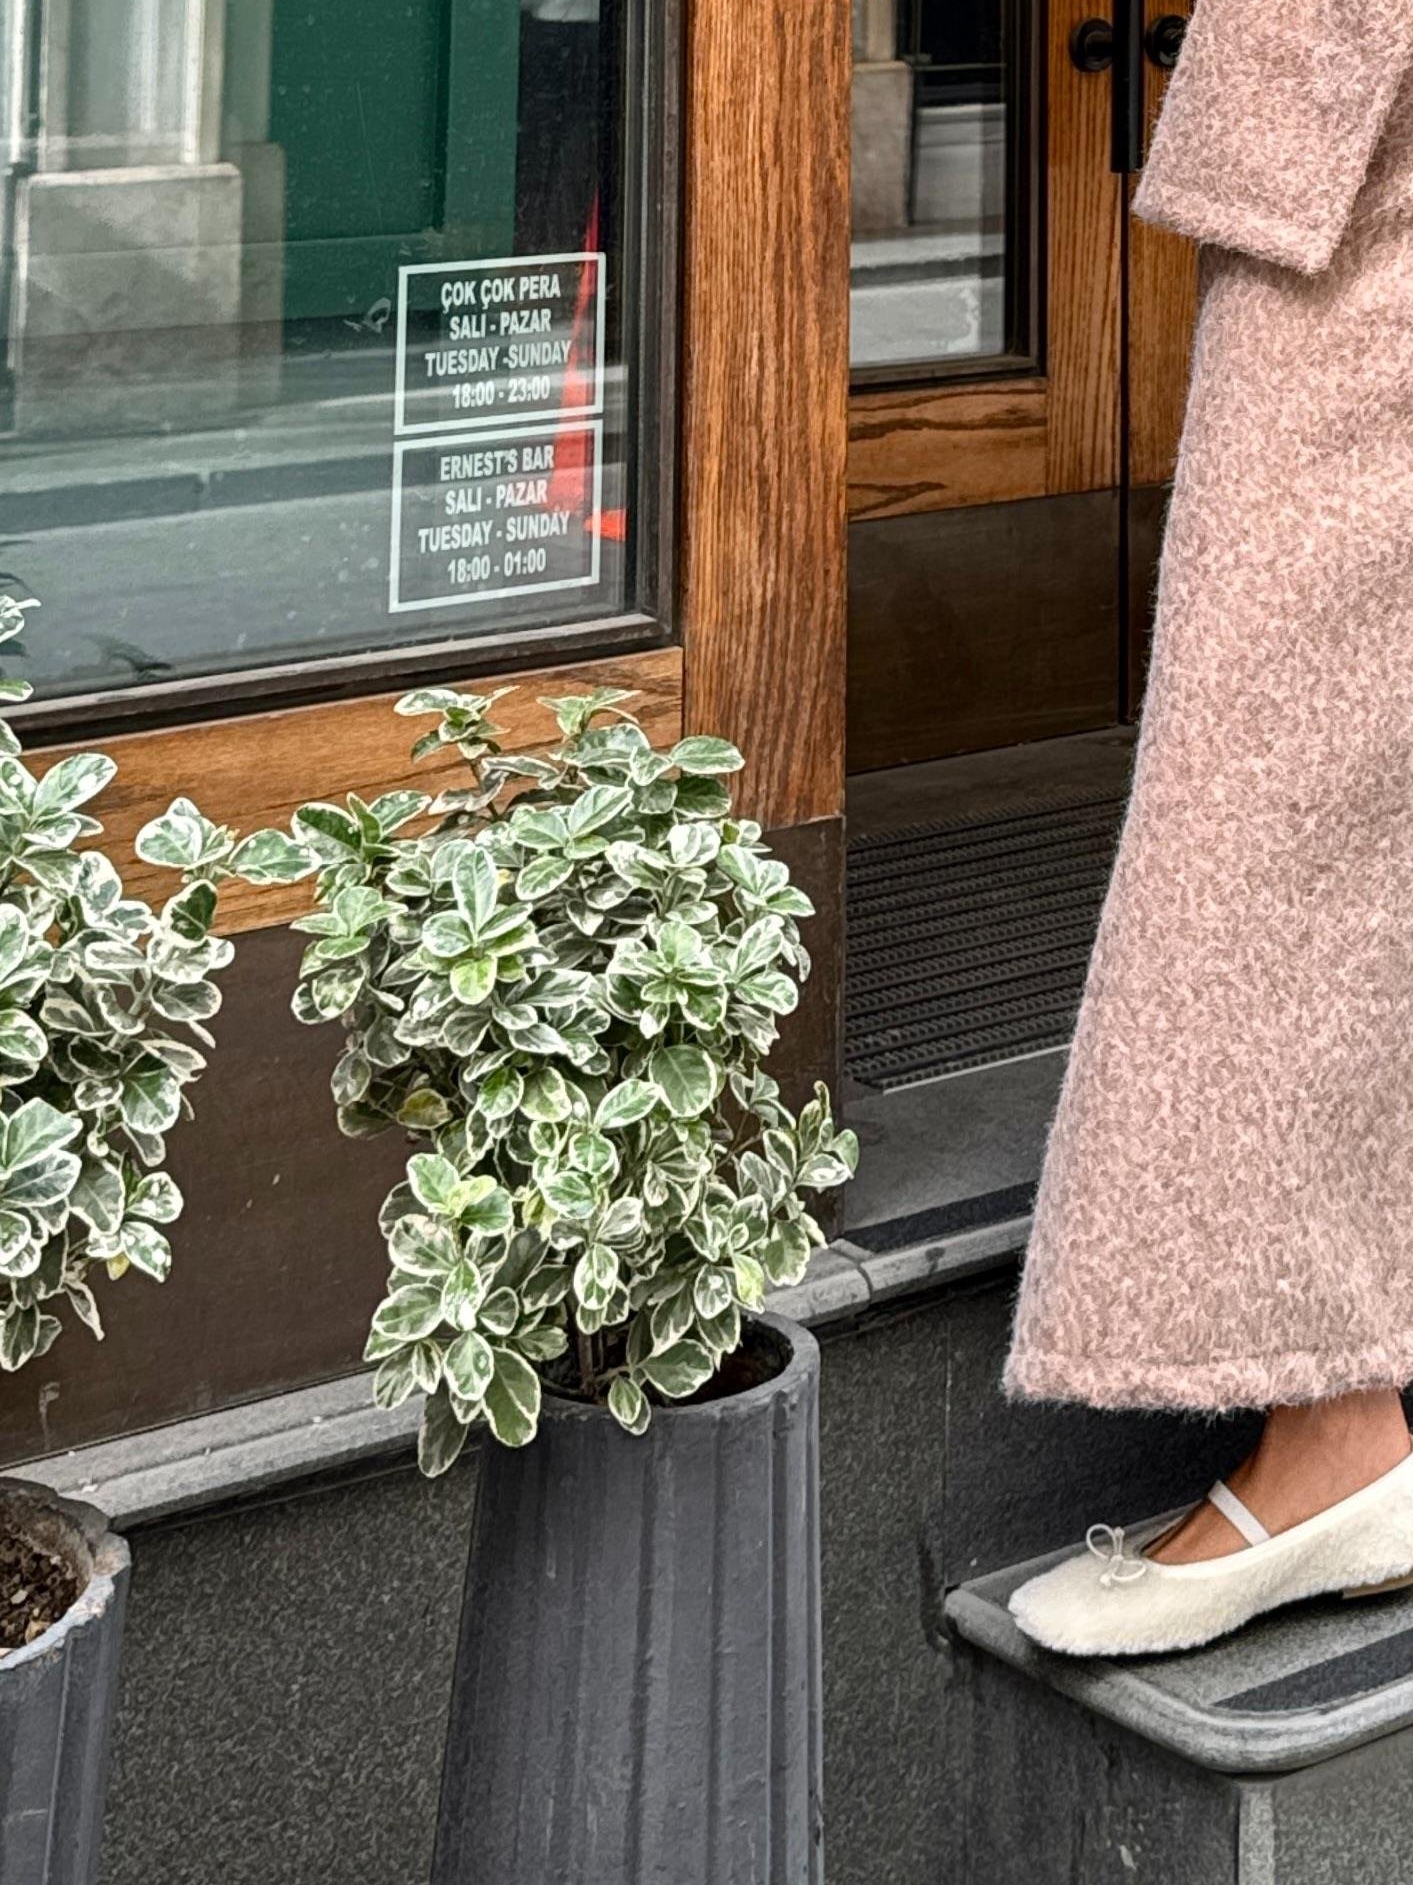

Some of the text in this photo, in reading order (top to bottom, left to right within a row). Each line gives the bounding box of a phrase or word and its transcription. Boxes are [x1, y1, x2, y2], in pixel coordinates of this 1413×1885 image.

[441, 274, 561, 313] ÇOK ÇOK PERA
[450, 314, 486, 340] SALI
[500, 309, 551, 336] PAZAR
[425, 346, 499, 377] TUESDAY
[452, 381, 494, 409] 18:00
[508, 376, 550, 403] 23:00
[440, 445, 555, 481] ERNEST'S BAR
[445, 487, 482, 515] SALI
[496, 479, 548, 509] PAZAR
[418, 520, 493, 553] TUESDAY
[506, 510, 570, 542] SUNDAY
[448, 555, 490, 584] 18:00
[504, 548, 547, 577] 01:00
